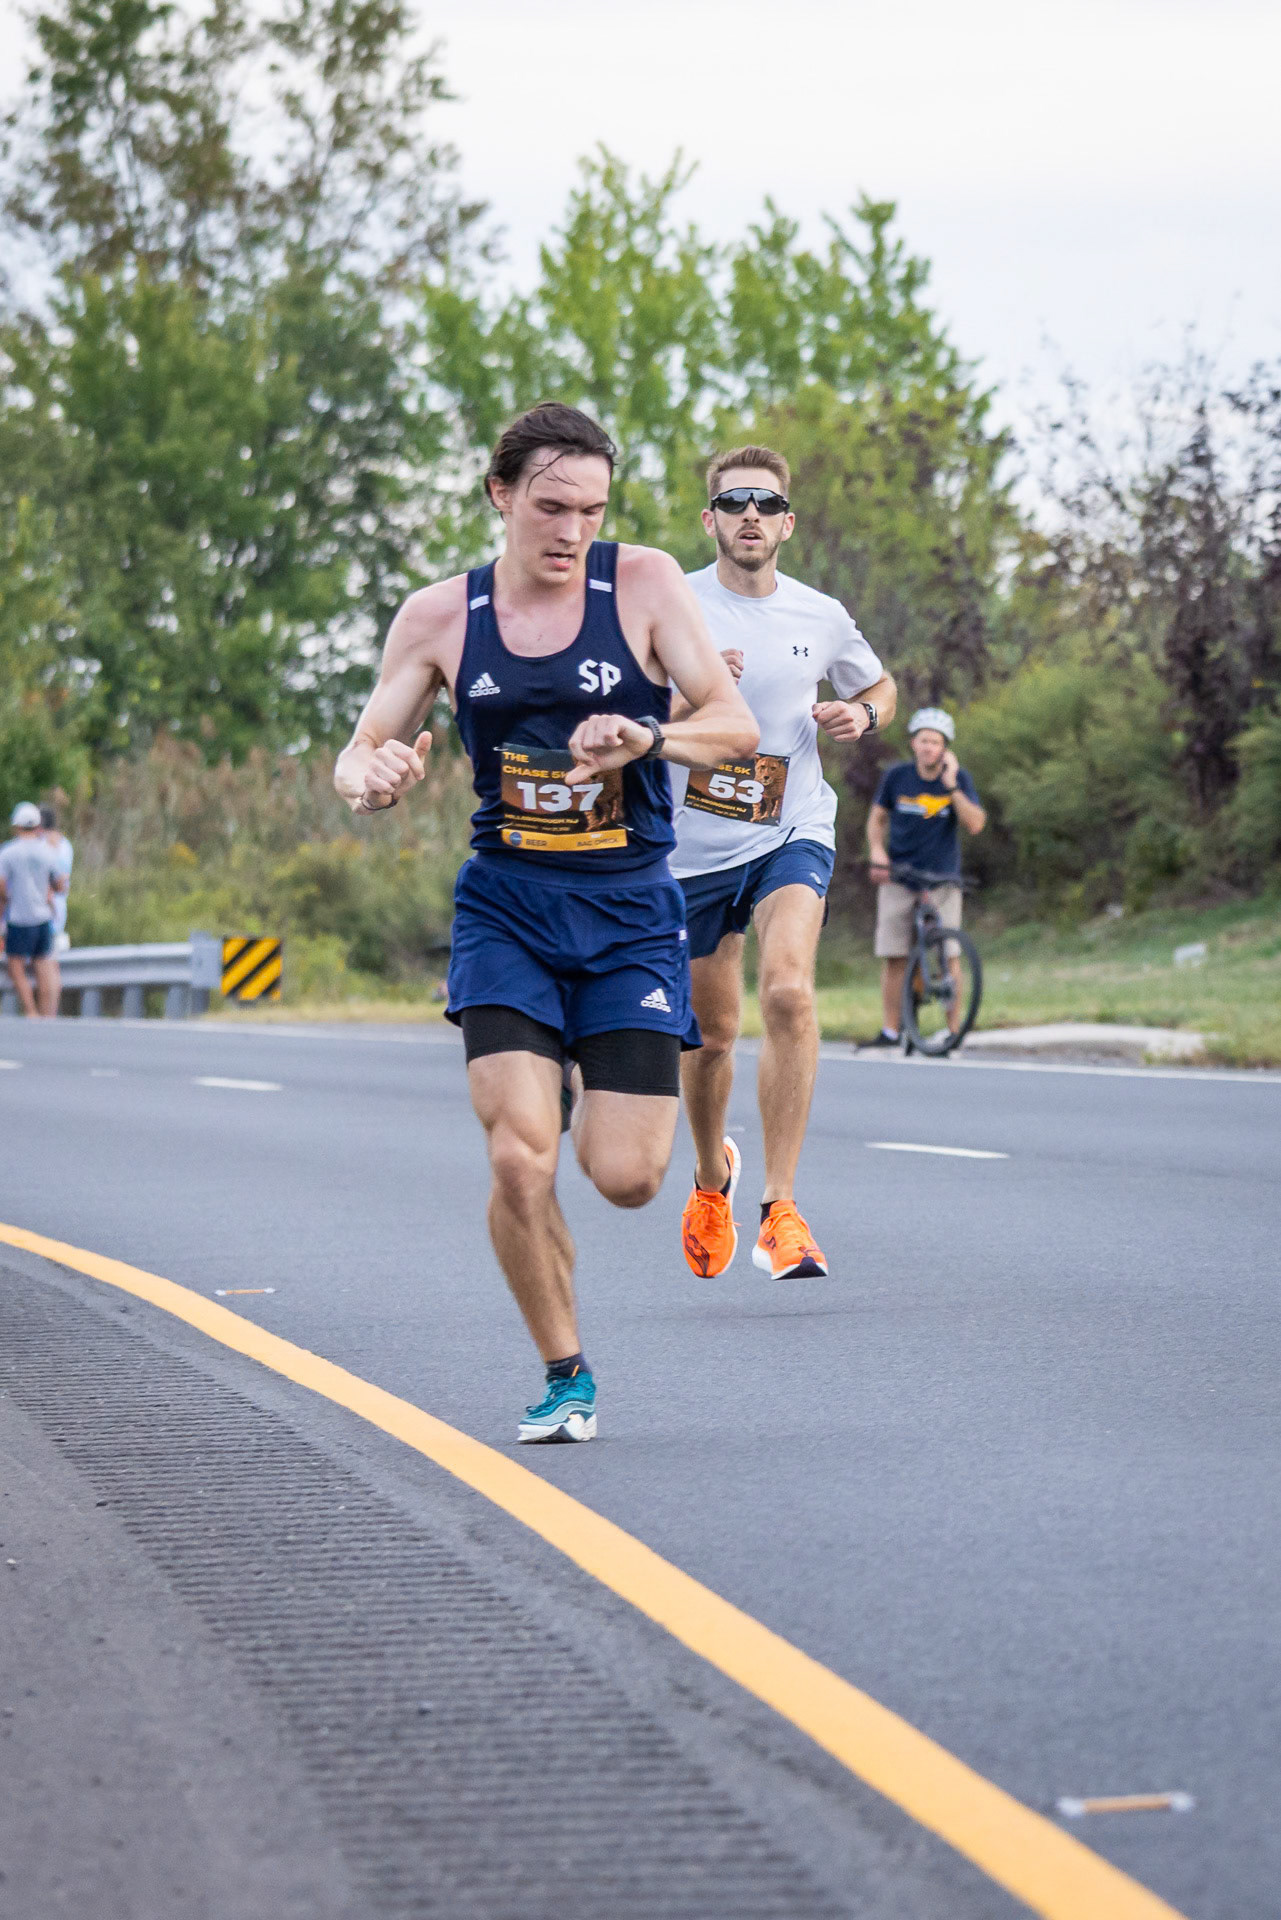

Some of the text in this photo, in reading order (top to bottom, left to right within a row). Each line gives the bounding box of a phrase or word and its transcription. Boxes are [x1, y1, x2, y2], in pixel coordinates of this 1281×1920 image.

[468, 686, 501, 698] adidas
[502, 751, 529, 763] THE
[502, 765, 549, 778] CHASE
[734, 765, 751, 775] 5K
[708, 774, 765, 804] 53
[517, 781, 604, 812] 137
[526, 838, 547, 847] BEER
[640, 999, 672, 1013] adidas
